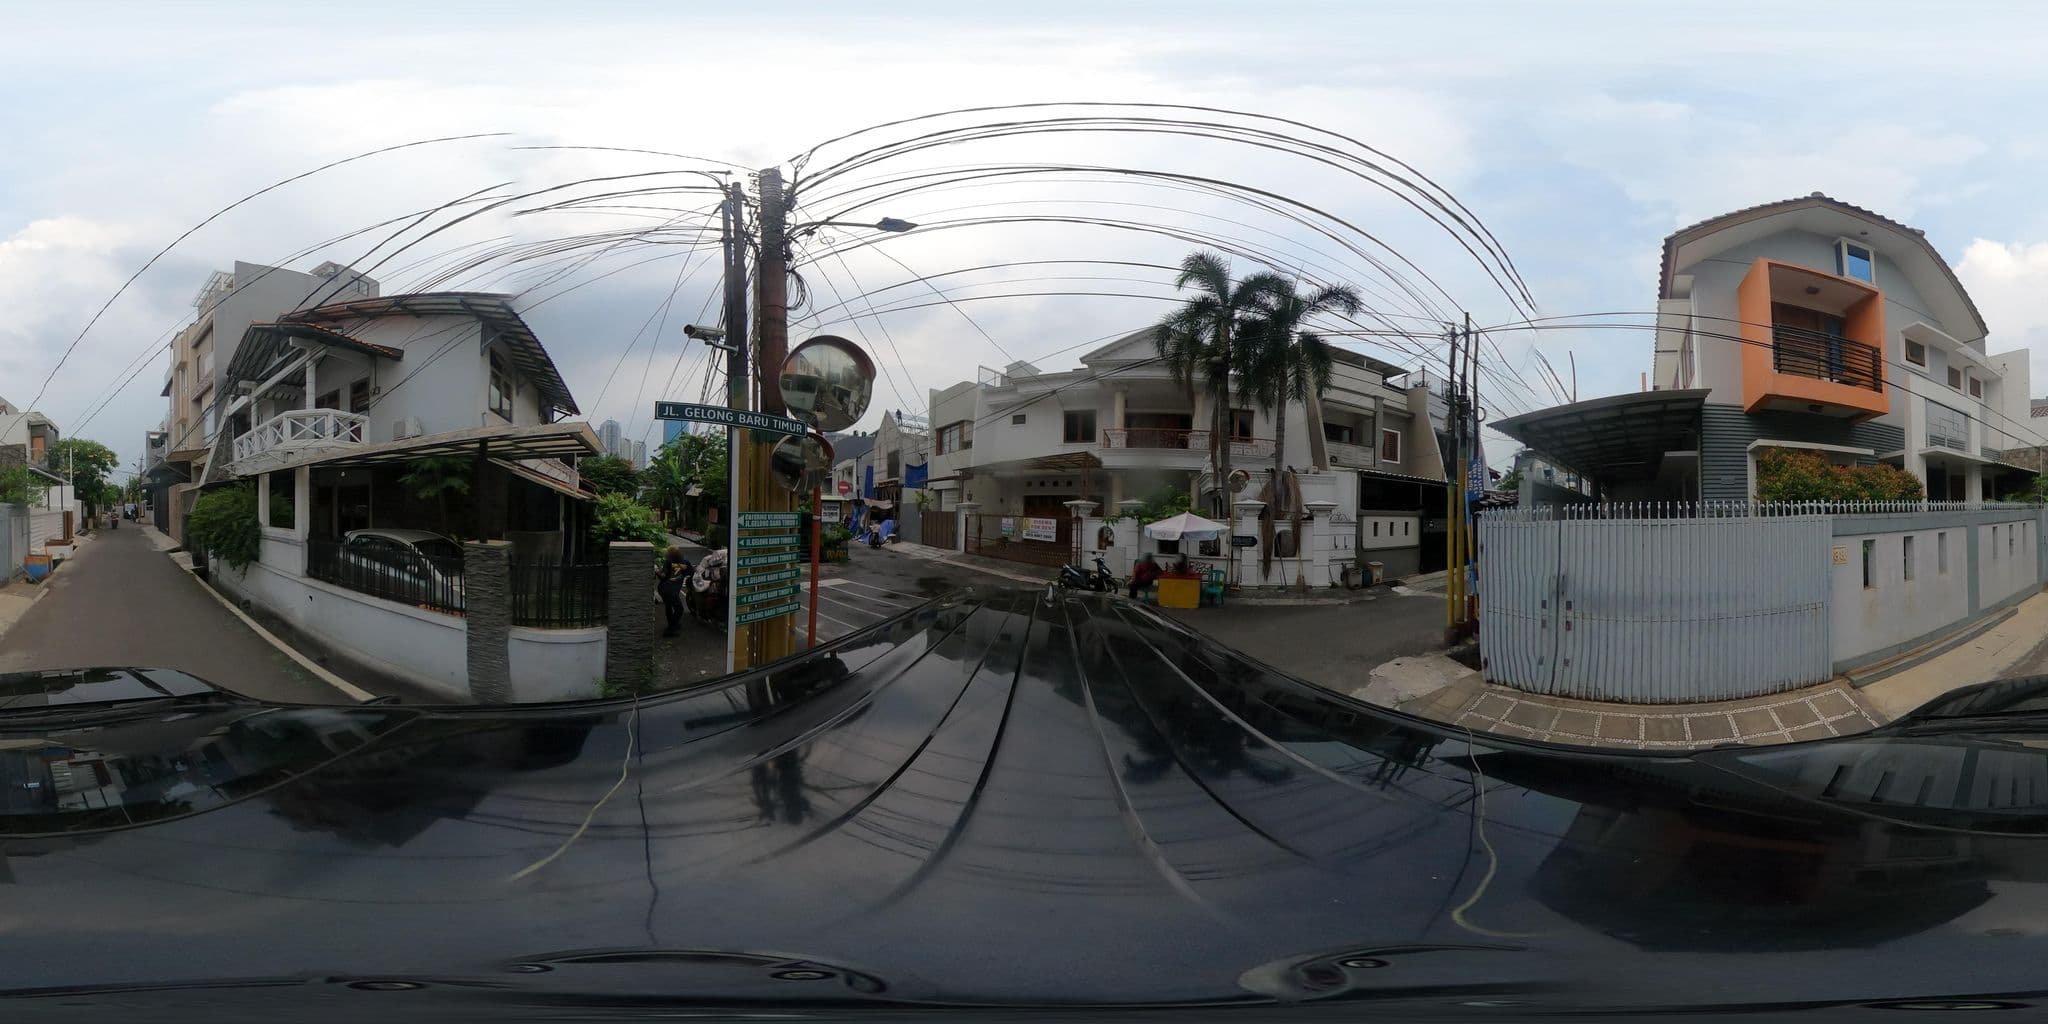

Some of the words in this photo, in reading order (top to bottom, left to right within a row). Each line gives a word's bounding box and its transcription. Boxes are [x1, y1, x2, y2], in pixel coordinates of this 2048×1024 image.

[663, 405, 679, 417] JL.
[684, 407, 734, 422] GELONG
[738, 413, 769, 427] BARU
[773, 419, 802, 434] TIMUR
